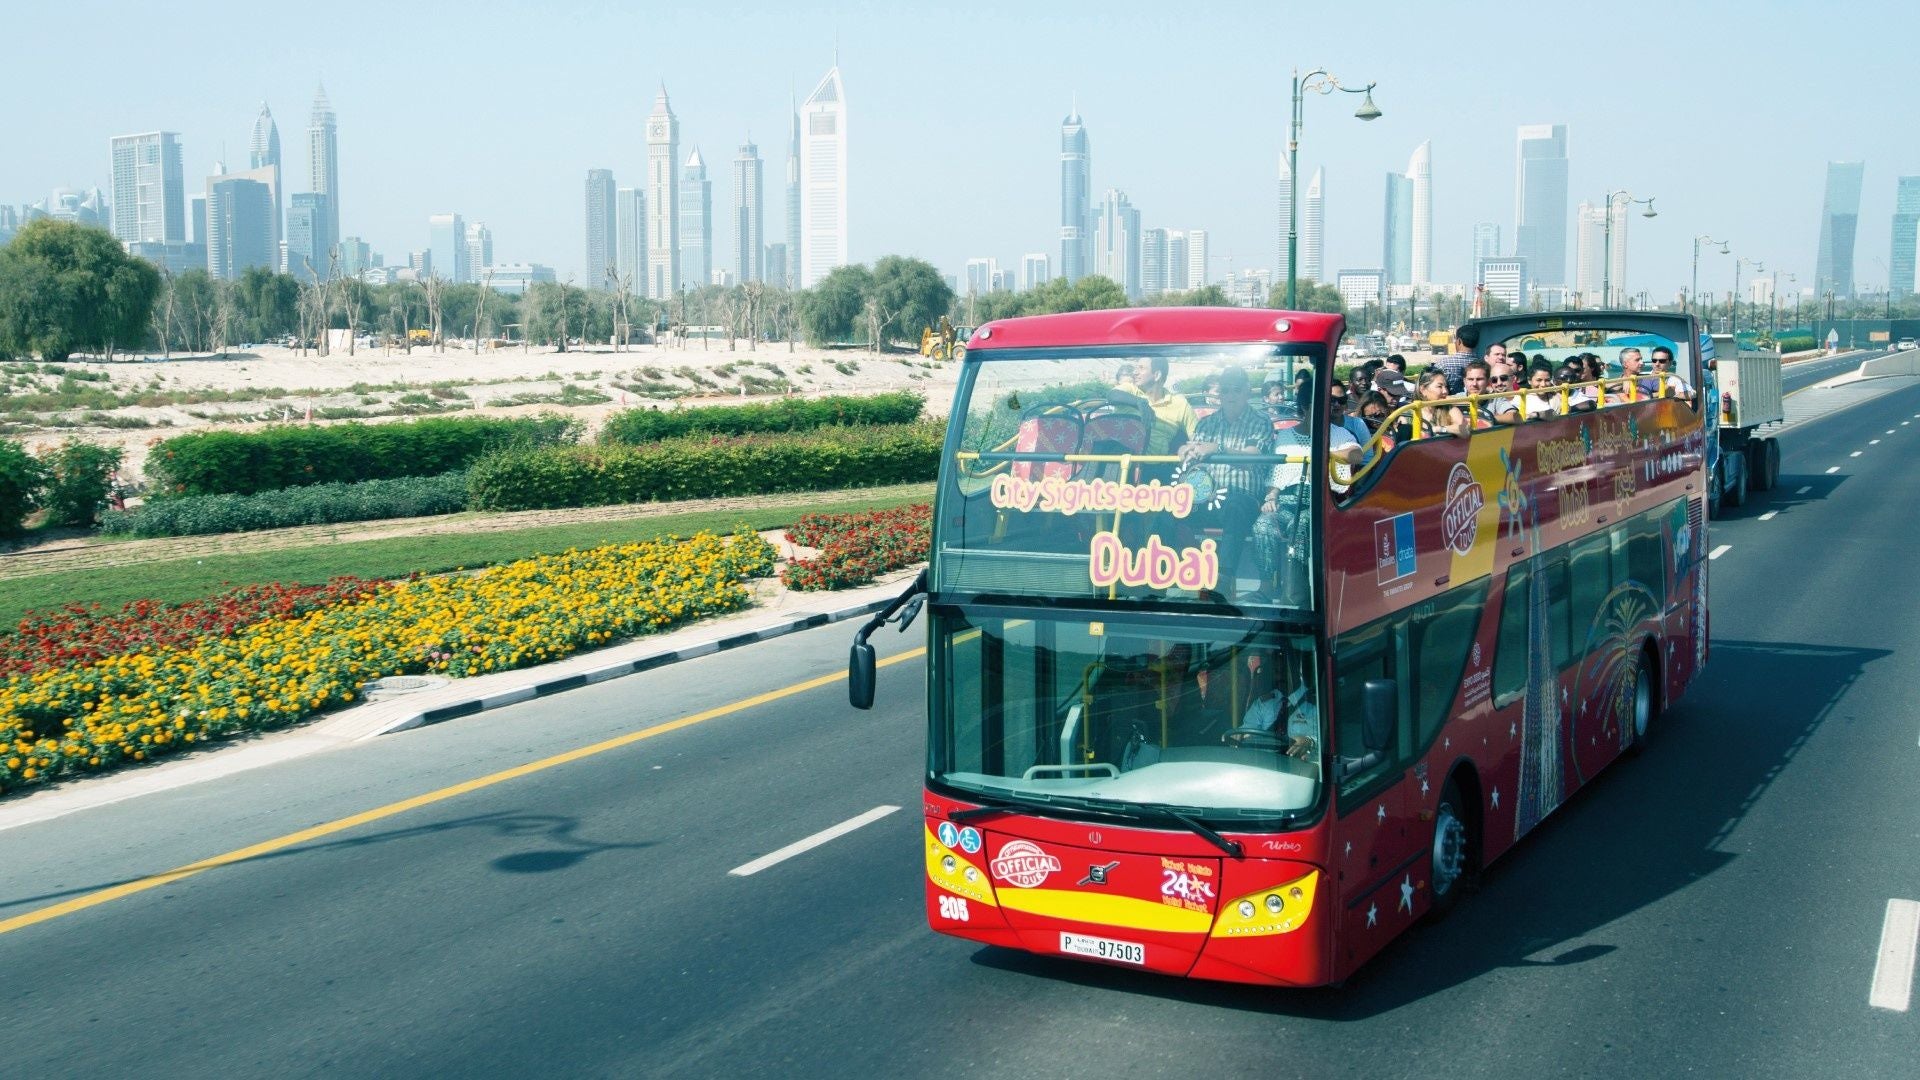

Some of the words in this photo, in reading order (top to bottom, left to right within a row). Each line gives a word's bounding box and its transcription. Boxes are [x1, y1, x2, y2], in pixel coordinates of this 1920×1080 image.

[1446, 486, 1483, 538] OFFICIAL
[1459, 519, 1476, 549] TOUR
[1089, 530, 1219, 591] Dubai
[997, 858, 1058, 874] OFFICIAL
[1017, 872, 1046, 886] TOUR
[1161, 869, 1188, 898] 24
[938, 894, 970, 922] 205
[1064, 936, 1072, 950] P
[1098, 940, 1142, 962] 97503
